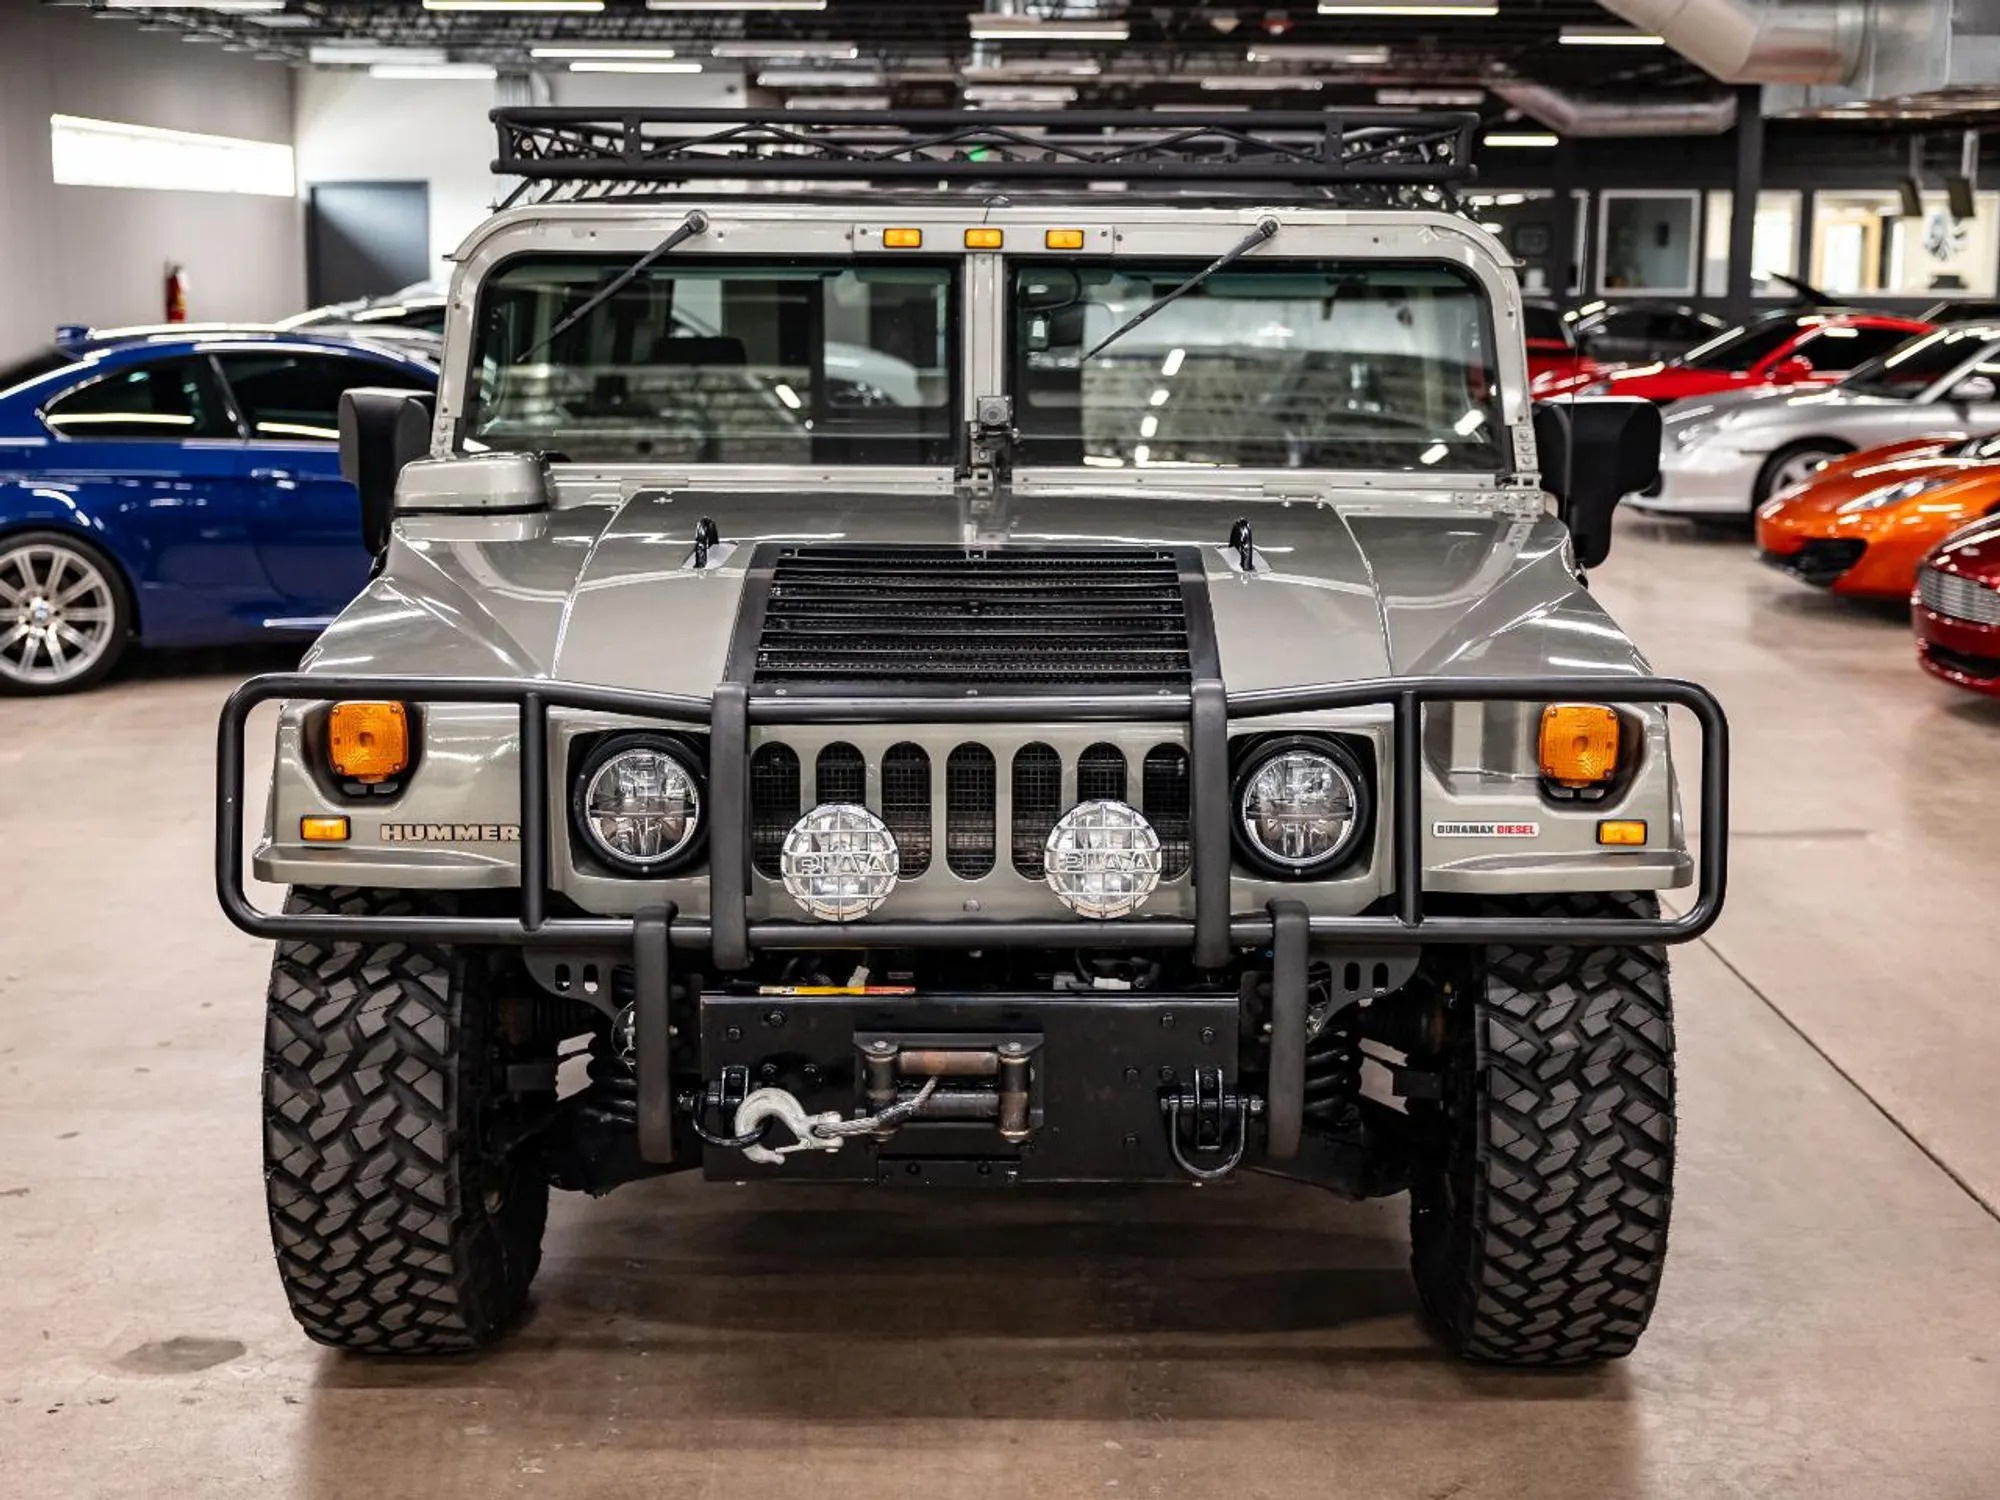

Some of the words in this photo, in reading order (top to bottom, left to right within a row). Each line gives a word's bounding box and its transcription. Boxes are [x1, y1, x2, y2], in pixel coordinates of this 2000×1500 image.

[380, 824, 521, 841] HUMMER
[1437, 825, 1494, 834] DURAMAX
[1496, 825, 1535, 834] DIESEL
